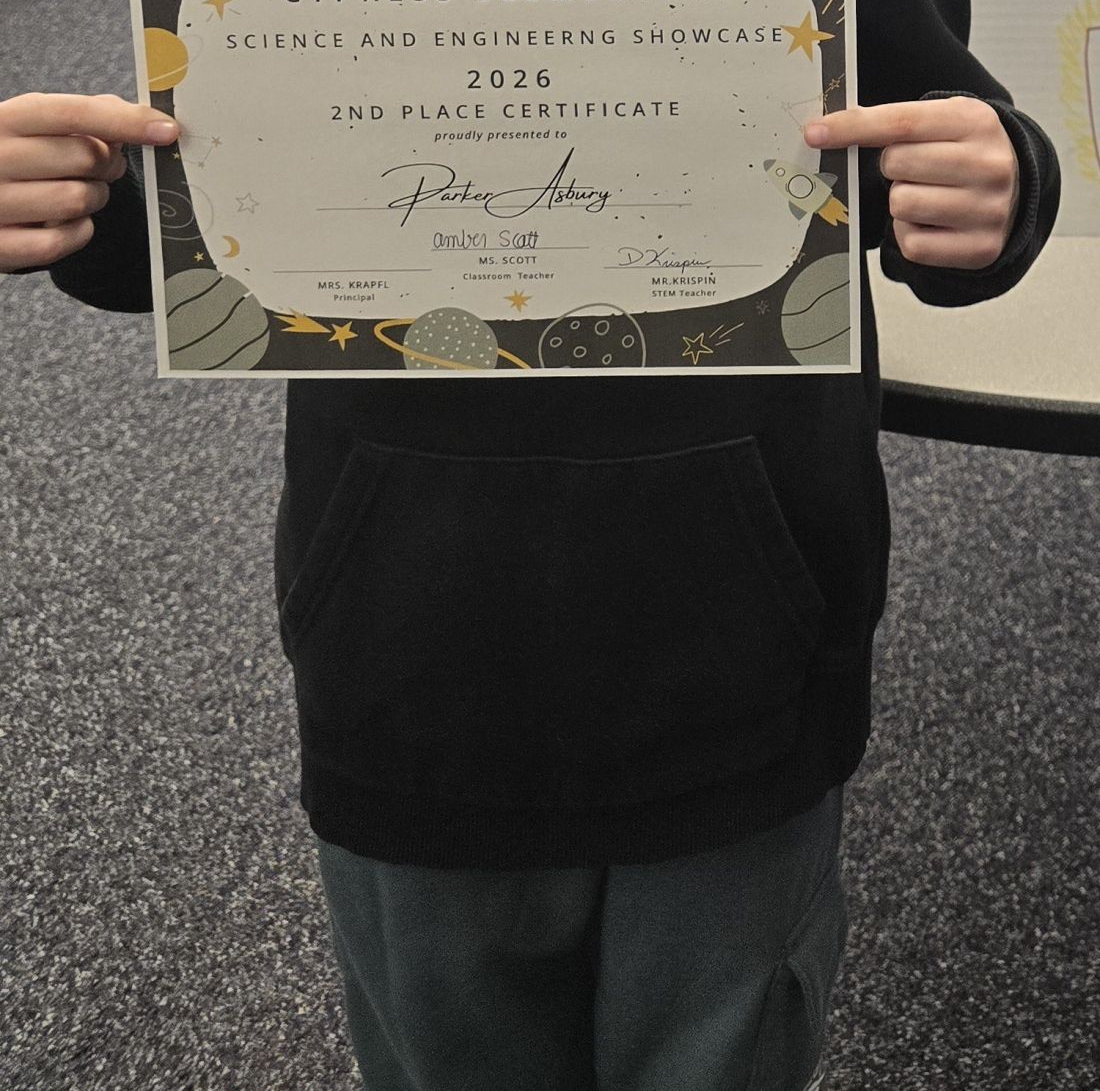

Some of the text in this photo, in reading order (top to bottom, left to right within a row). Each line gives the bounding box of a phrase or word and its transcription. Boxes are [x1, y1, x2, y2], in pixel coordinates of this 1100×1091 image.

[226, 27, 784, 49] SCIENCE AND ENGINEERNG SHOWCASE
[466, 68, 552, 89] 2026
[331, 101, 680, 121] 2ND PLACE CERTIFICATE
[434, 127, 568, 142] proudly presented to
[381, 147, 612, 227] Parker Asbury
[478, 255, 537, 265] MS. SCOTT
[462, 271, 555, 281] Classroom Teacher
[651, 276, 717, 286] MR.KRISPIN
[317, 280, 390, 290] MRS. KRAPFL
[333, 293, 375, 303] Principal
[651, 289, 717, 298] STEM Teacher
